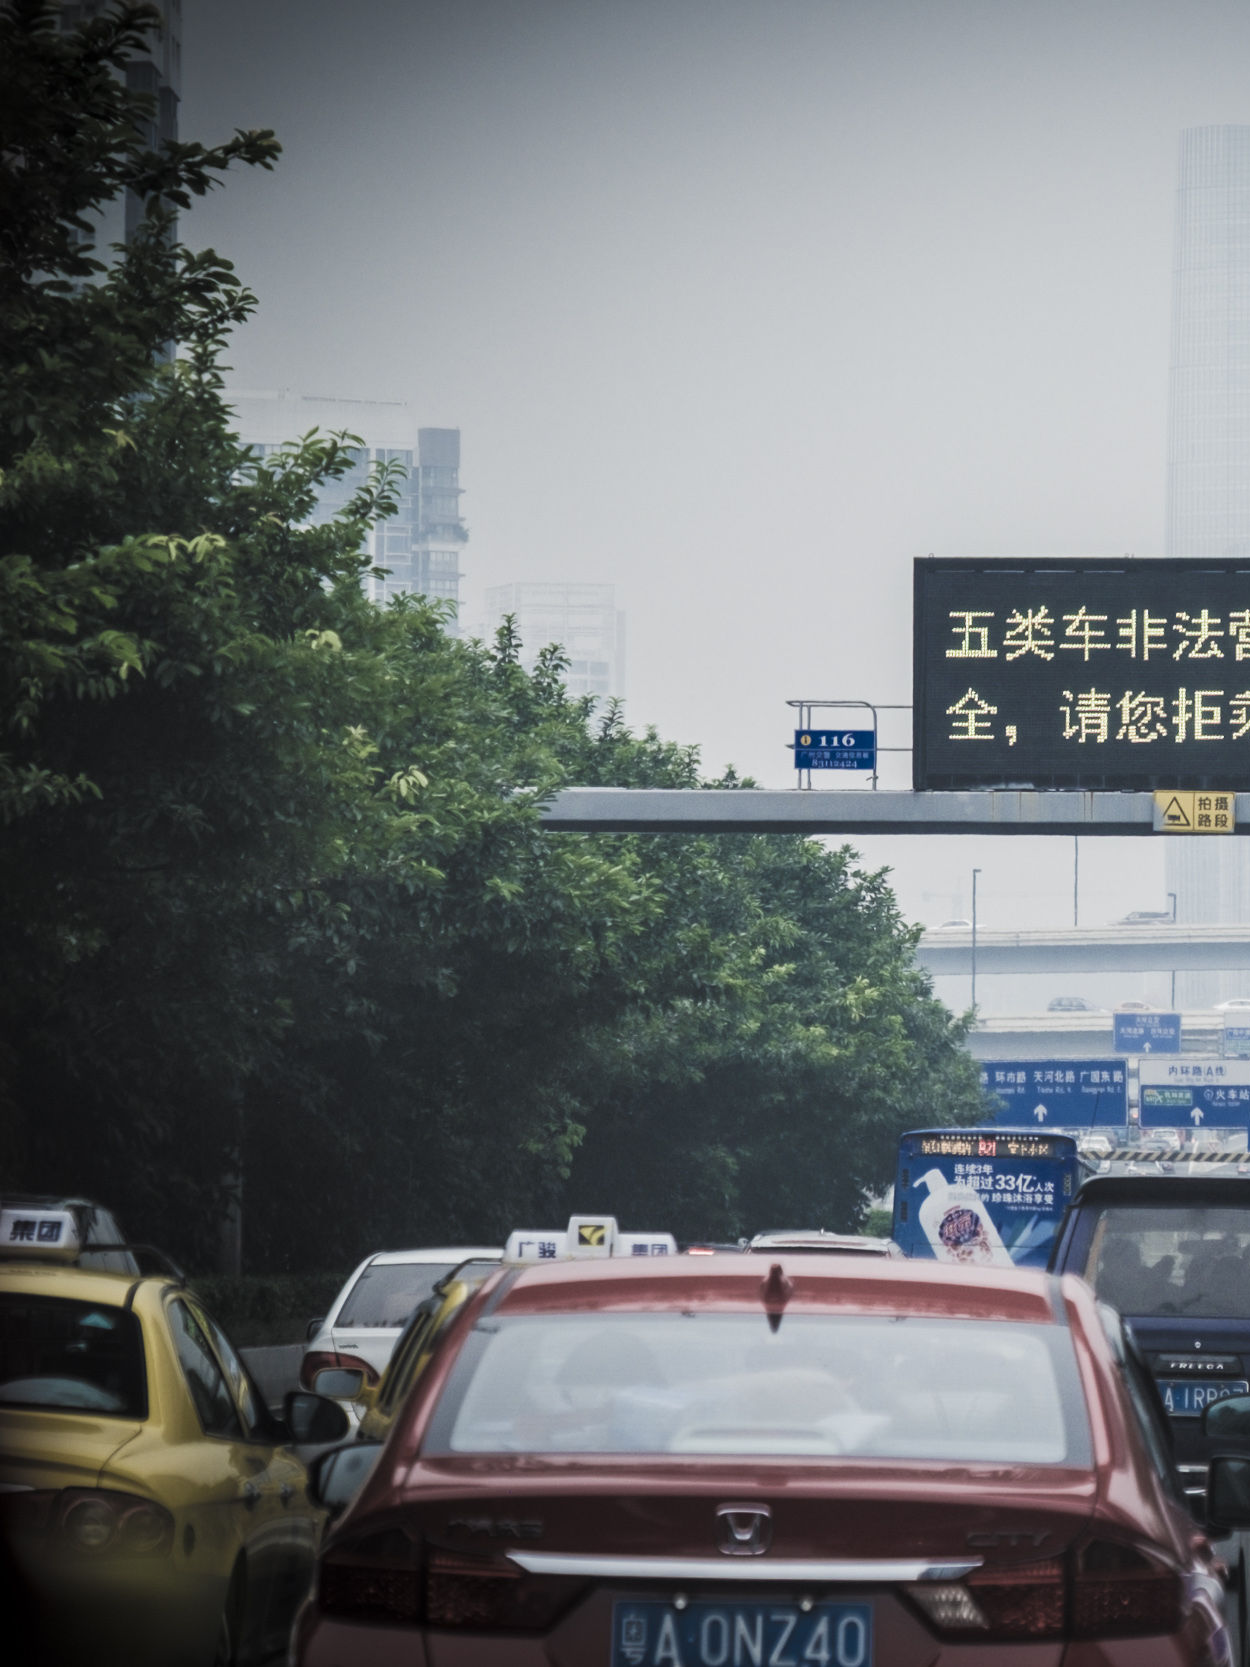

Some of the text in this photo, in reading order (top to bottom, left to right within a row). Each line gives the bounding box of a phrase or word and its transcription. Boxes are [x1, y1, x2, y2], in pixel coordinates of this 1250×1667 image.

[818, 733, 855, 748] 116
[1198, 796, 1229, 811] 拍摄
[1198, 813, 1229, 828] 路段
[1215, 1088, 1250, 1101] 火车站
[9, 1219, 63, 1242] 集团
[517, 1240, 557, 1259] 广骏
